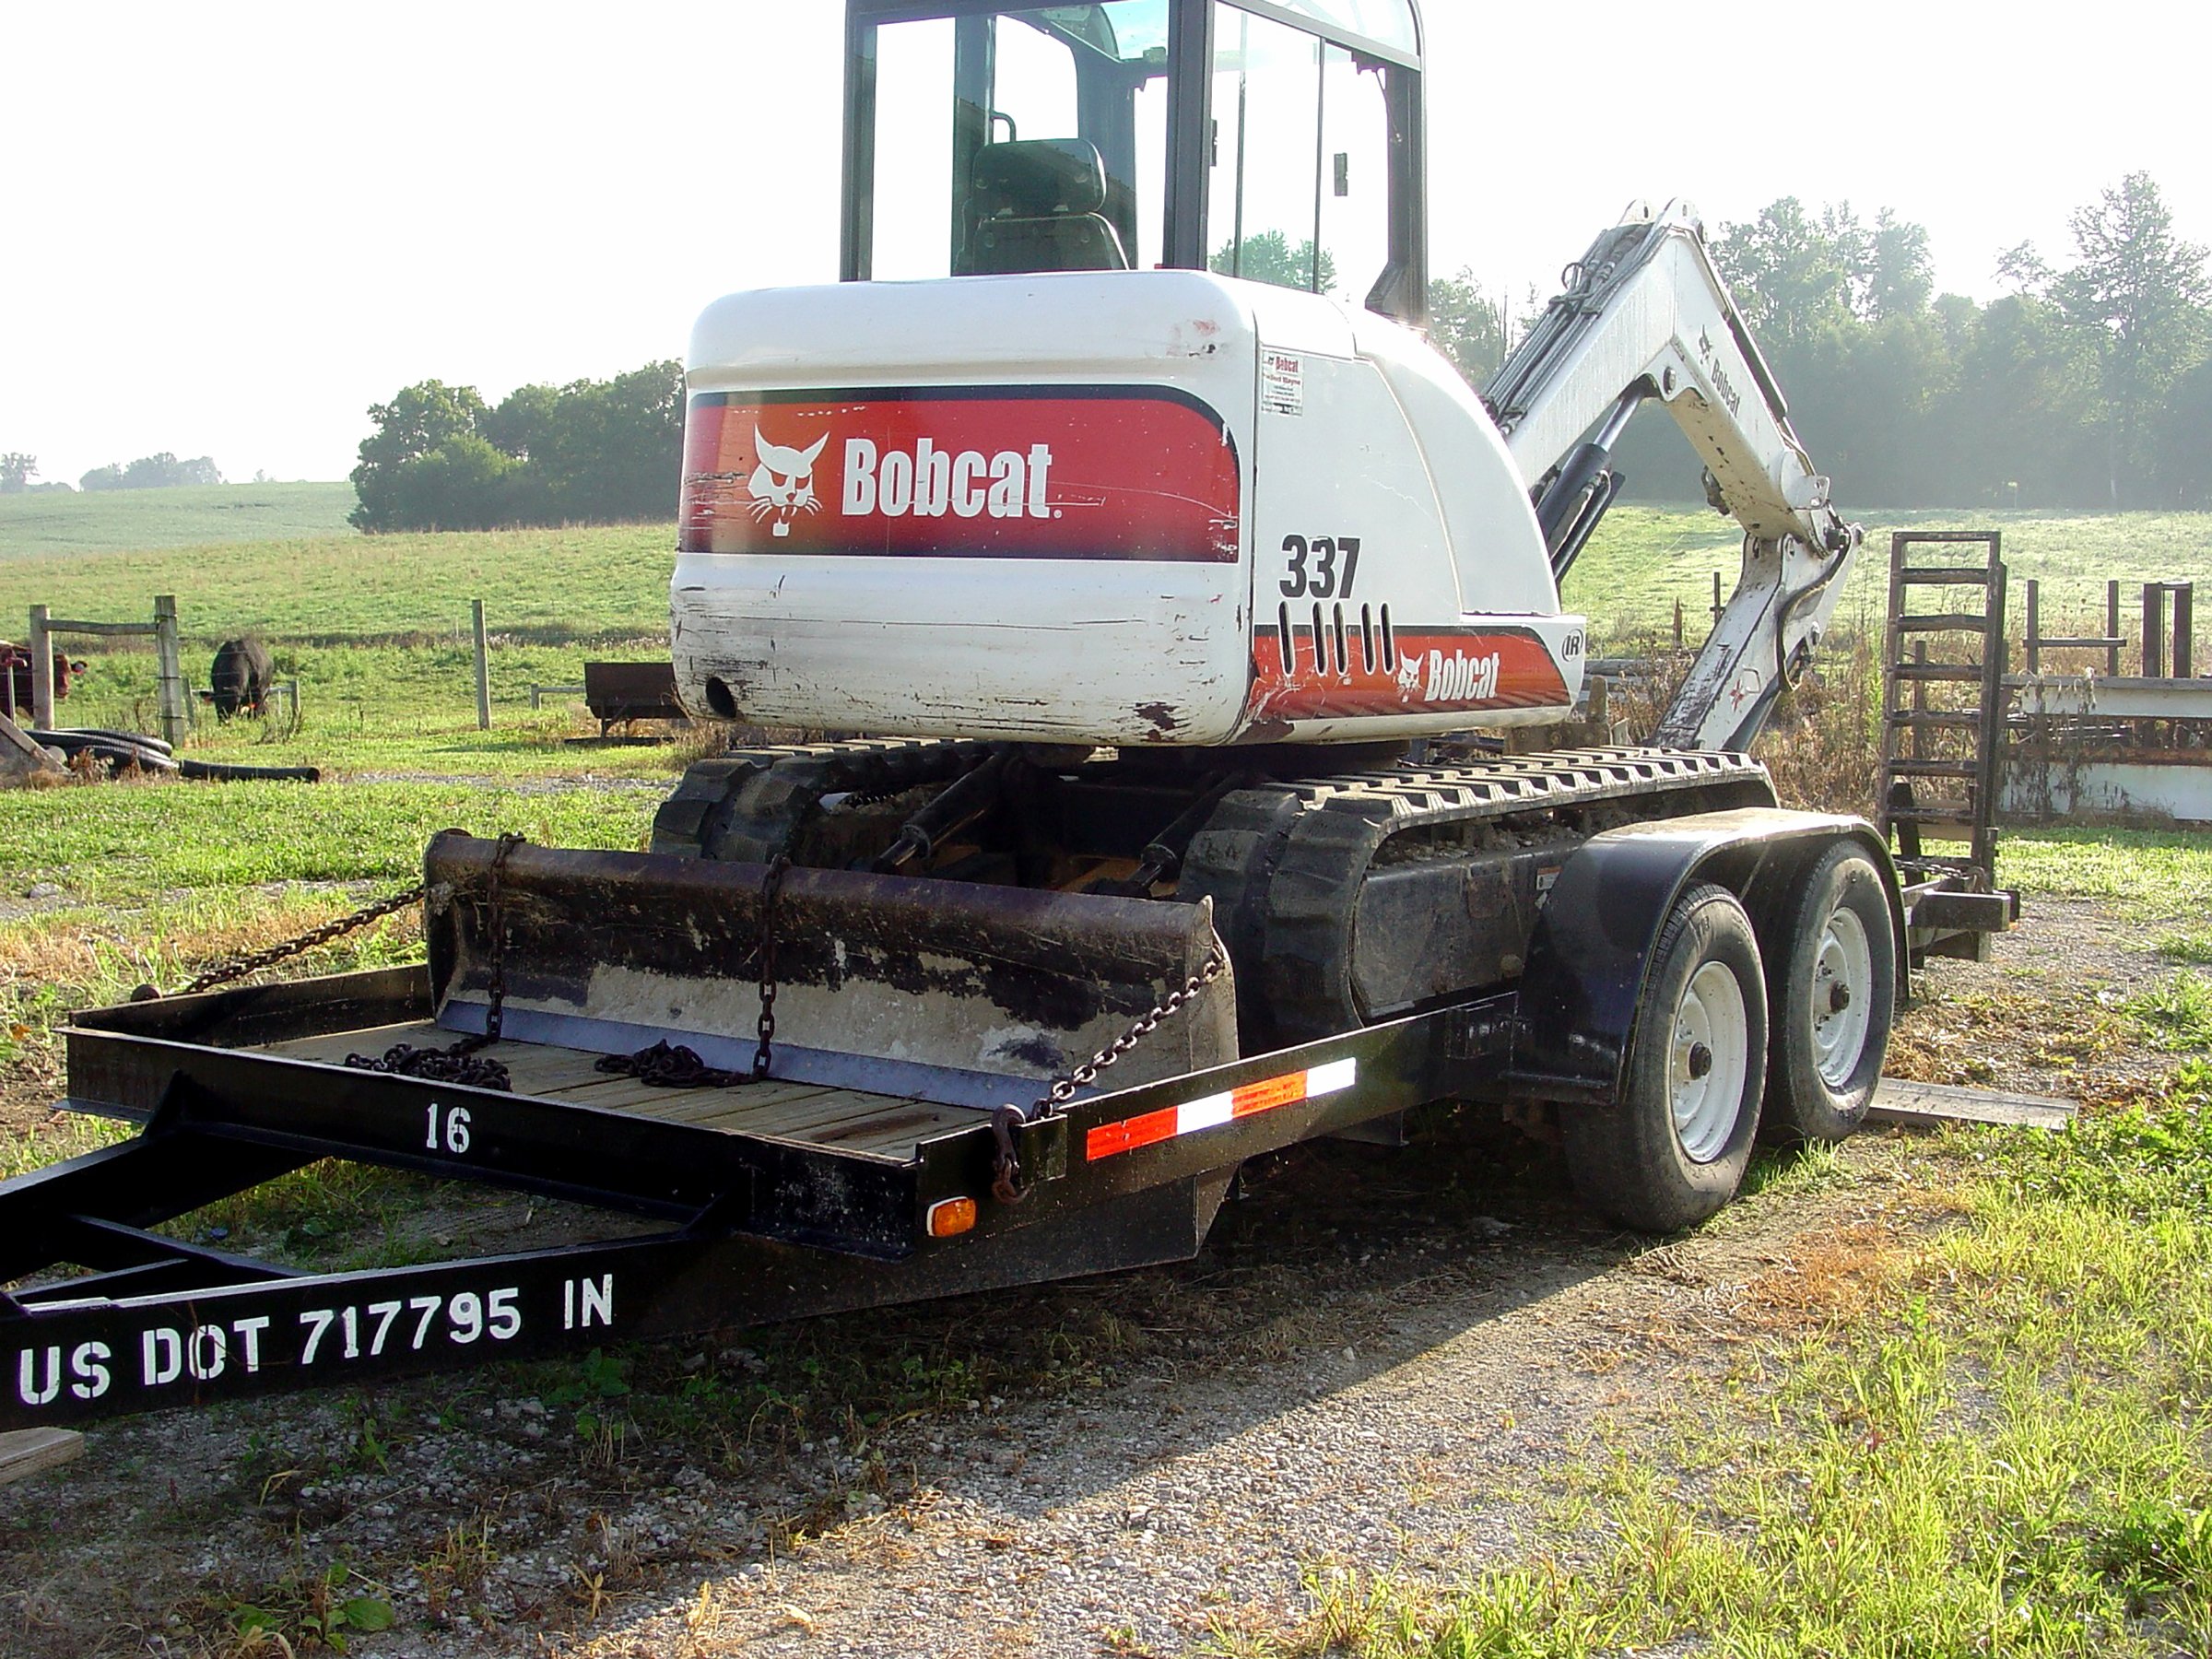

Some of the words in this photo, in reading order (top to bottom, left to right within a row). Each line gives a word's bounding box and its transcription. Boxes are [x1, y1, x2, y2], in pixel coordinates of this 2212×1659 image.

[1711, 358, 1741, 418] Bobcat
[841, 437, 1053, 519] Bobcat
[1278, 534, 1361, 599] 337
[1424, 648, 1500, 701] Bobcat
[1565, 635, 1581, 656] IR
[426, 1102, 472, 1154] 16
[19, 1341, 112, 1406] US
[142, 1315, 270, 1386] DOT
[300, 1287, 522, 1365] 717795
[564, 1273, 614, 1330] IN
